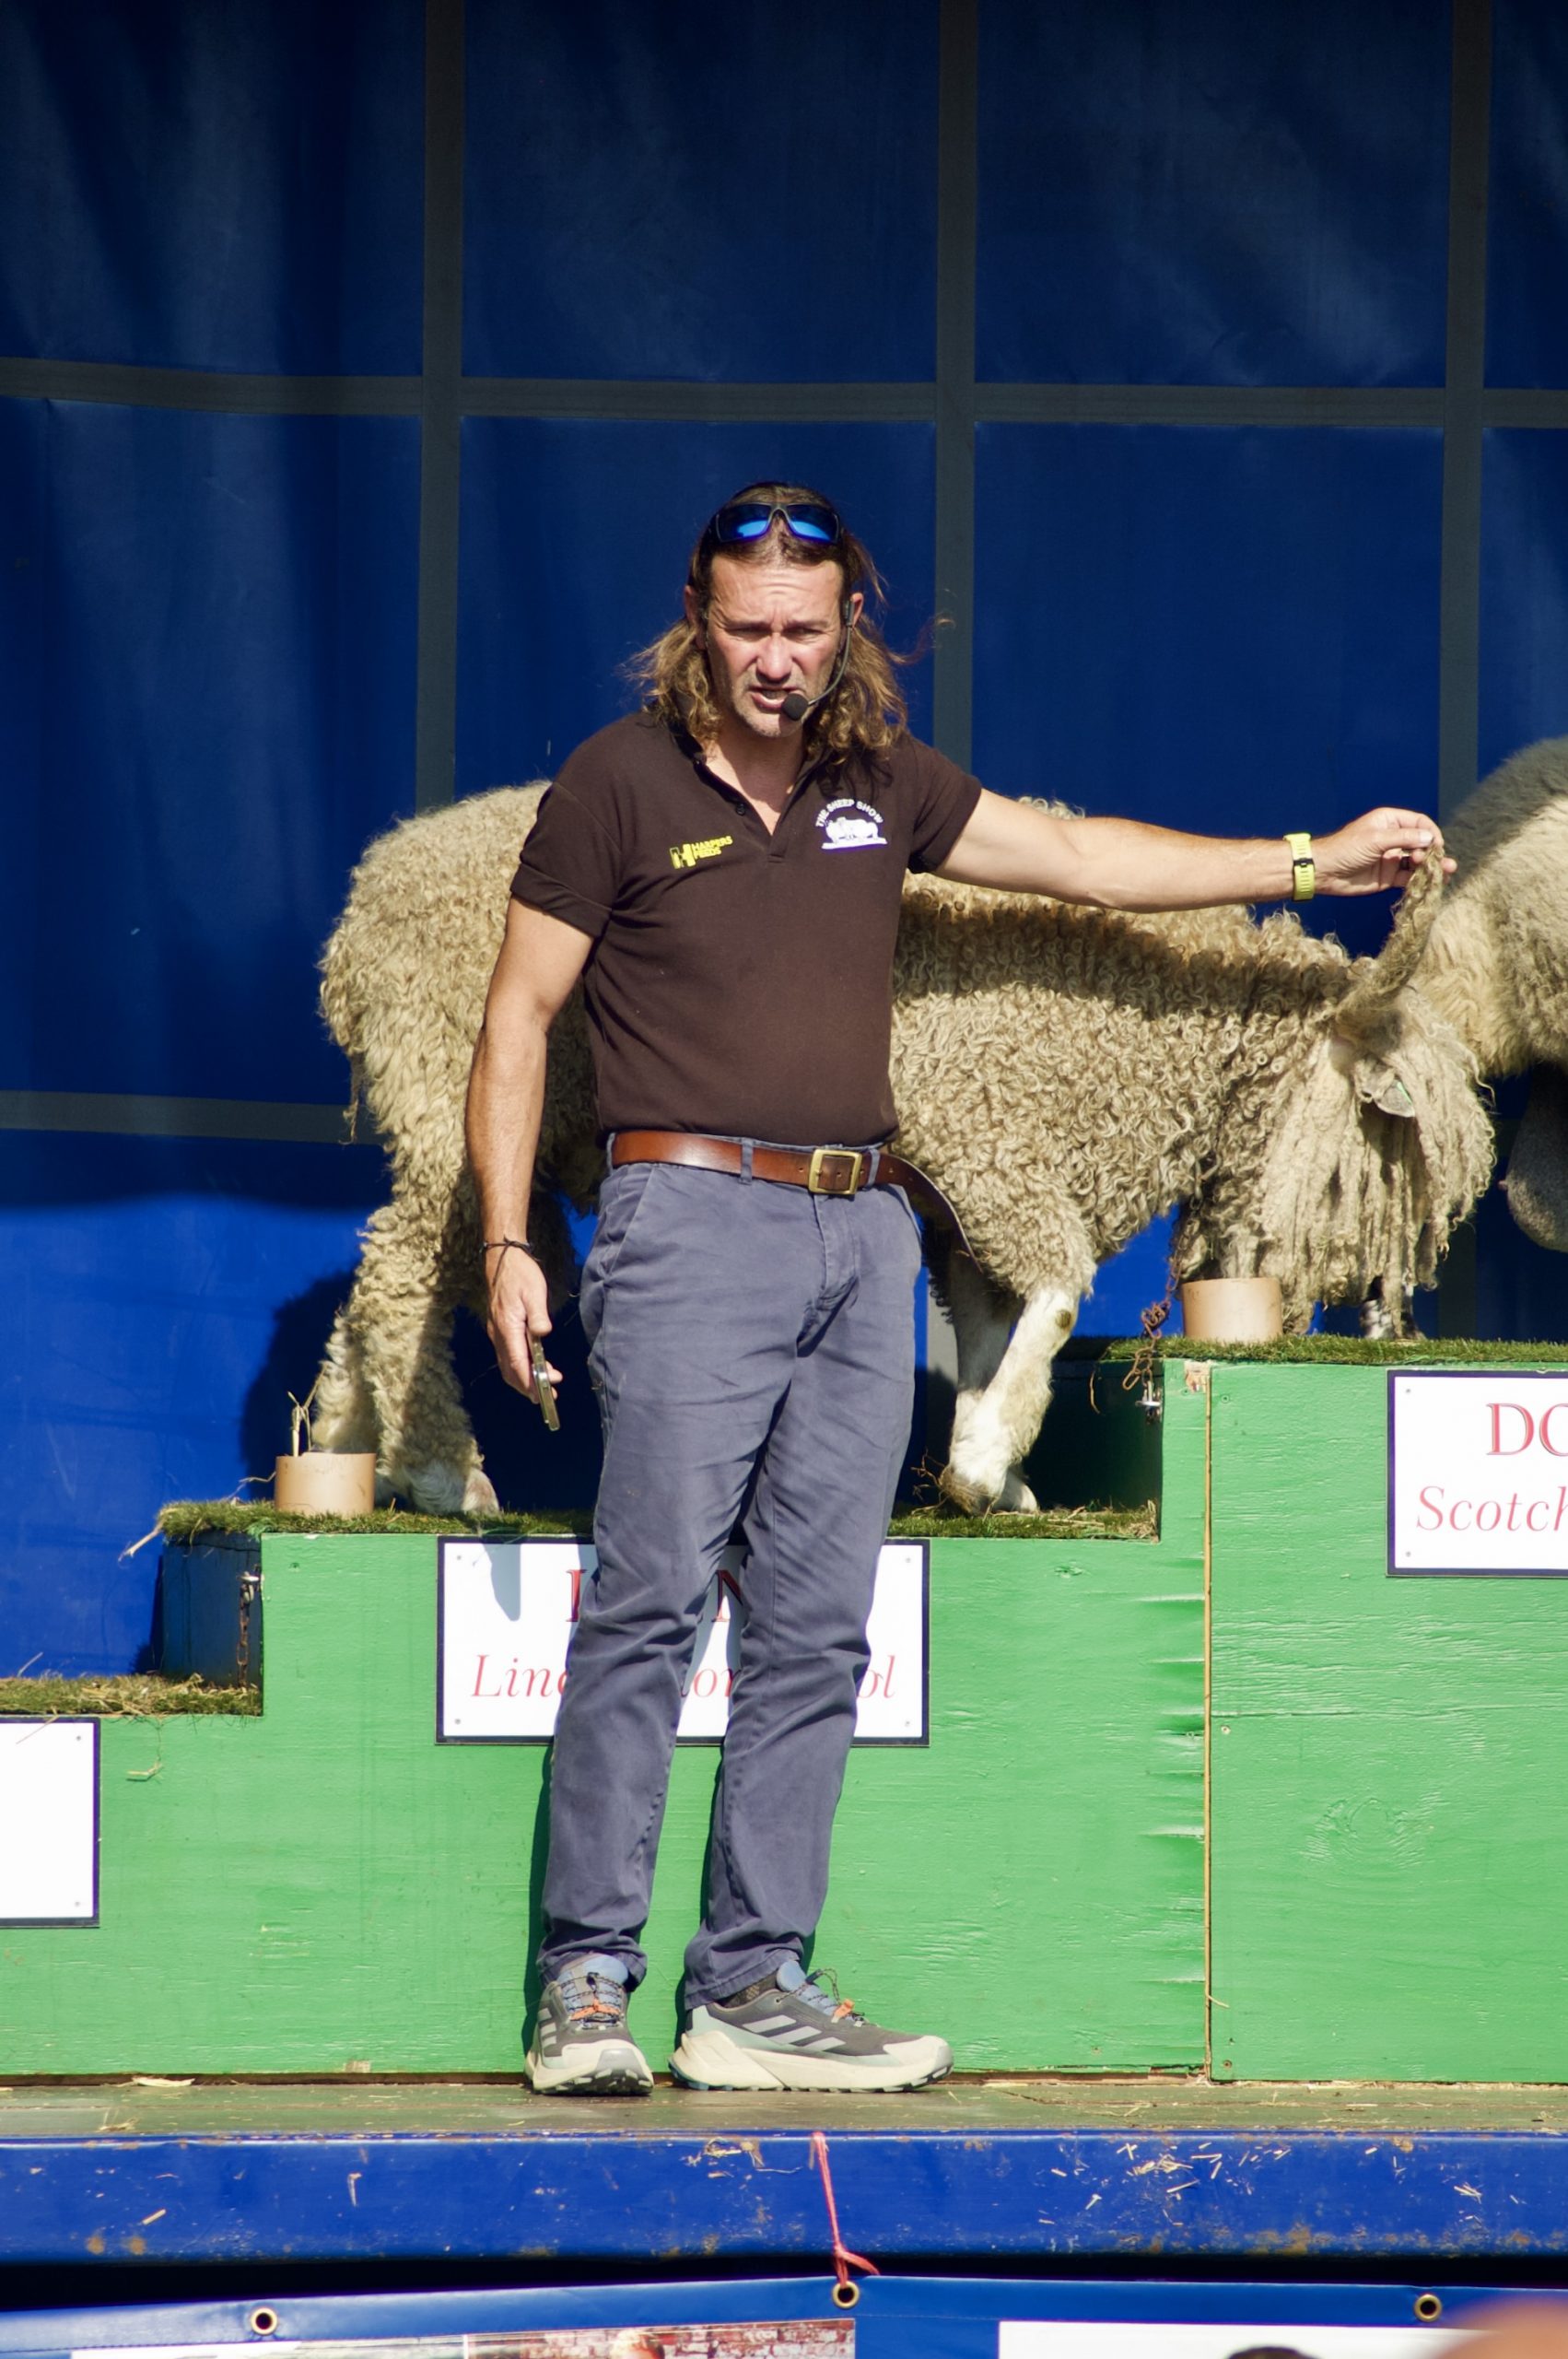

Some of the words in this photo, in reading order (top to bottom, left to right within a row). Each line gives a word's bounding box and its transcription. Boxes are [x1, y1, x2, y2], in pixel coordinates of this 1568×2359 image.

[815, 809, 830, 827] THE
[826, 798, 855, 812] SHEEP
[856, 801, 883, 823] SHOW
[691, 835, 733, 852] HARPERS
